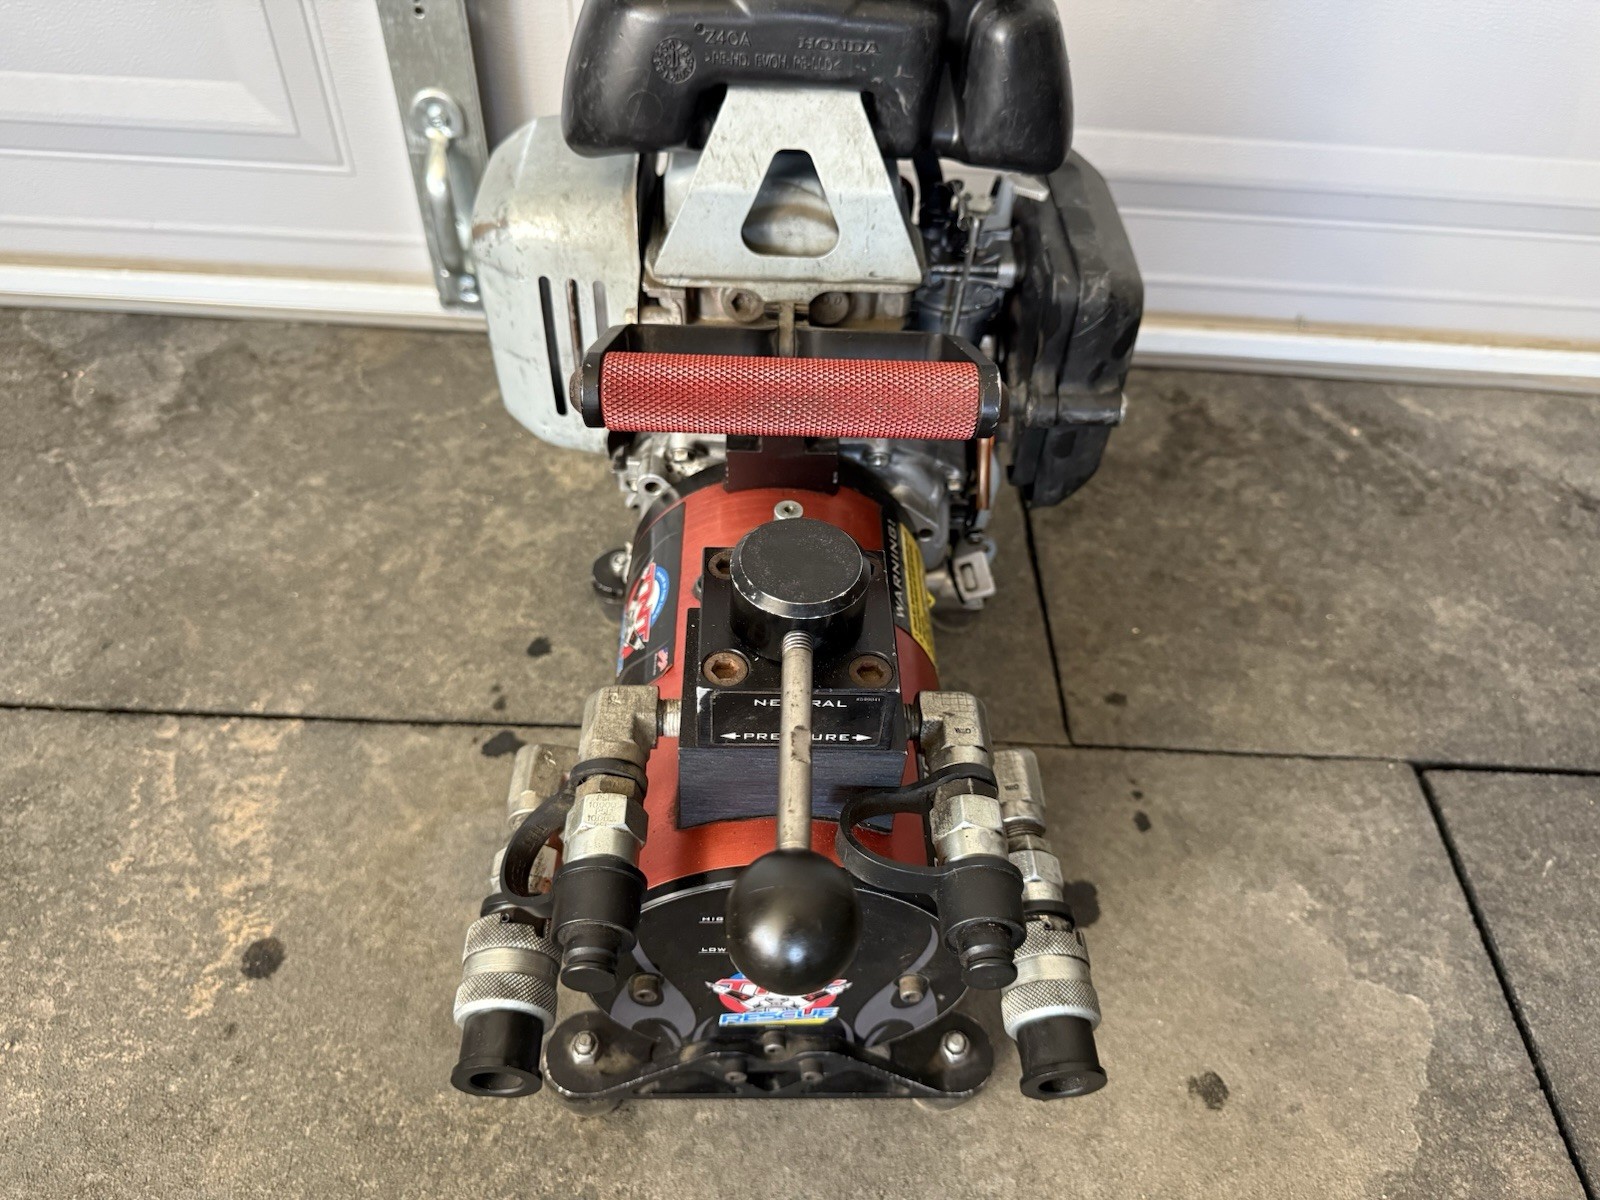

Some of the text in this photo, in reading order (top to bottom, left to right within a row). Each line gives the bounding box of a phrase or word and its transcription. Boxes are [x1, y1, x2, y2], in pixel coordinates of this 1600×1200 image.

[798, 37, 880, 54] HONDA
[887, 518, 905, 618] WARNING!
[753, 698, 847, 708] NERAL
[743, 732, 850, 742] PREURE
[718, 1007, 840, 1027] RESCUE
